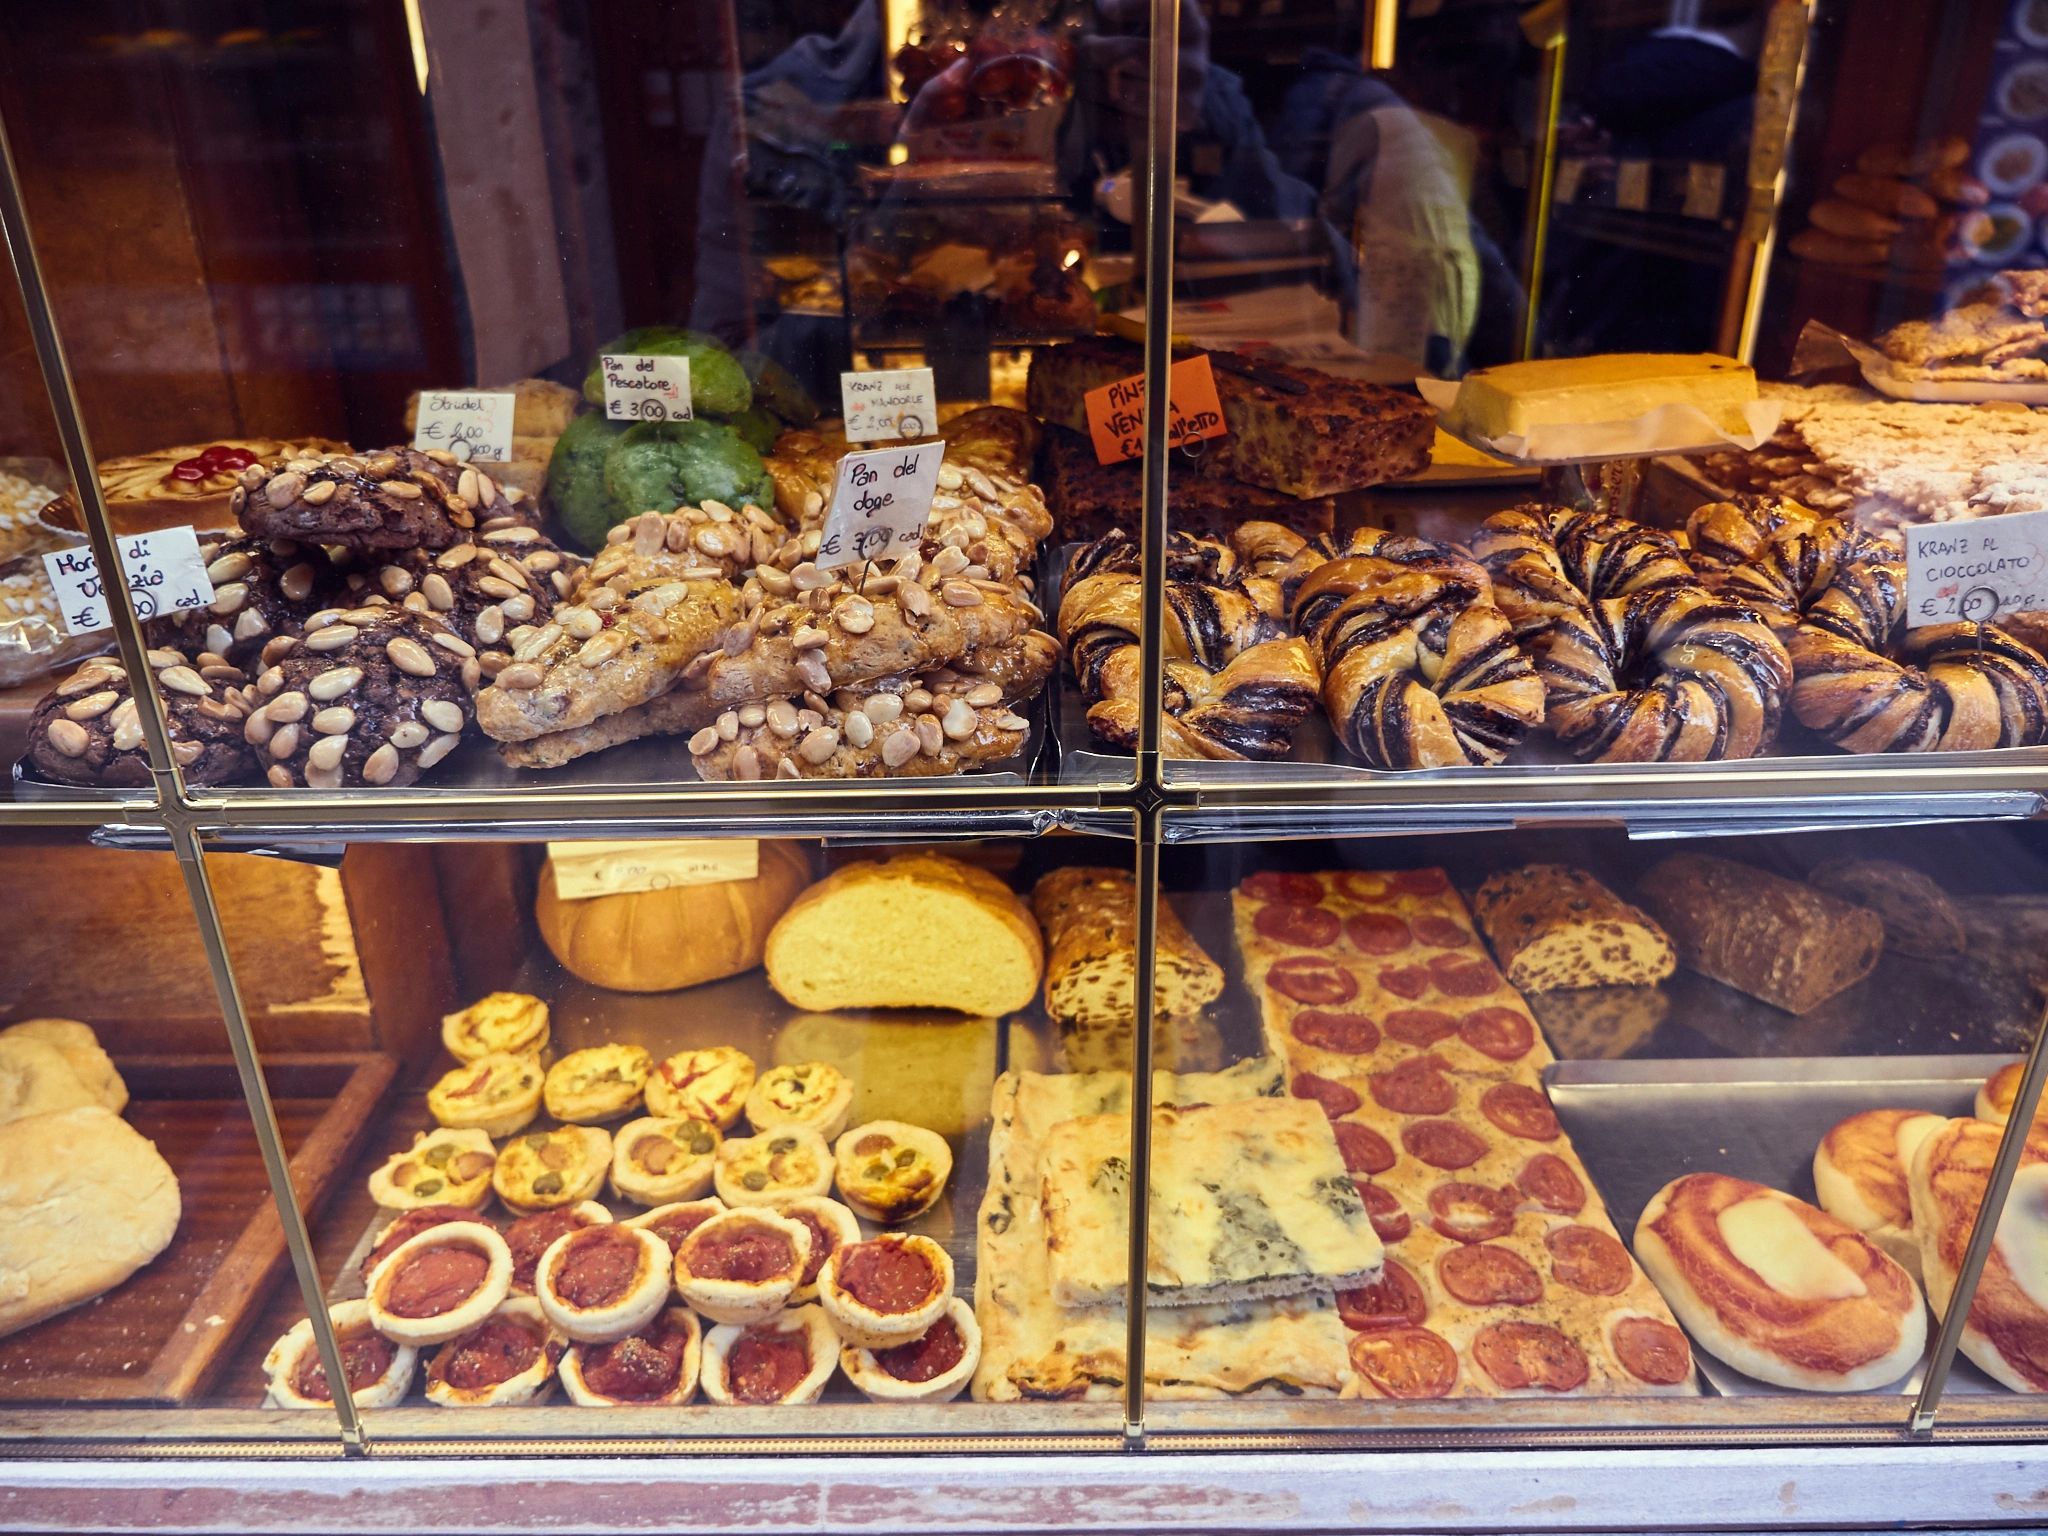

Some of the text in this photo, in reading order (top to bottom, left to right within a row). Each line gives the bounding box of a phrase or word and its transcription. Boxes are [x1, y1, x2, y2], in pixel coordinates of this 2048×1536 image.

[602, 357, 654, 372] Pan del
[607, 373, 671, 391] Pescatore
[609, 400, 622, 414] €
[420, 421, 445, 440] €
[851, 454, 919, 486] Pan del
[854, 490, 894, 518] doge
[129, 540, 151, 559] di
[819, 535, 841, 555] €
[1918, 538, 1999, 558] KRANZ AL
[1926, 556, 2030, 582] CIOCCOLATO
[72, 607, 100, 627] €
[1920, 598, 1938, 617] €
